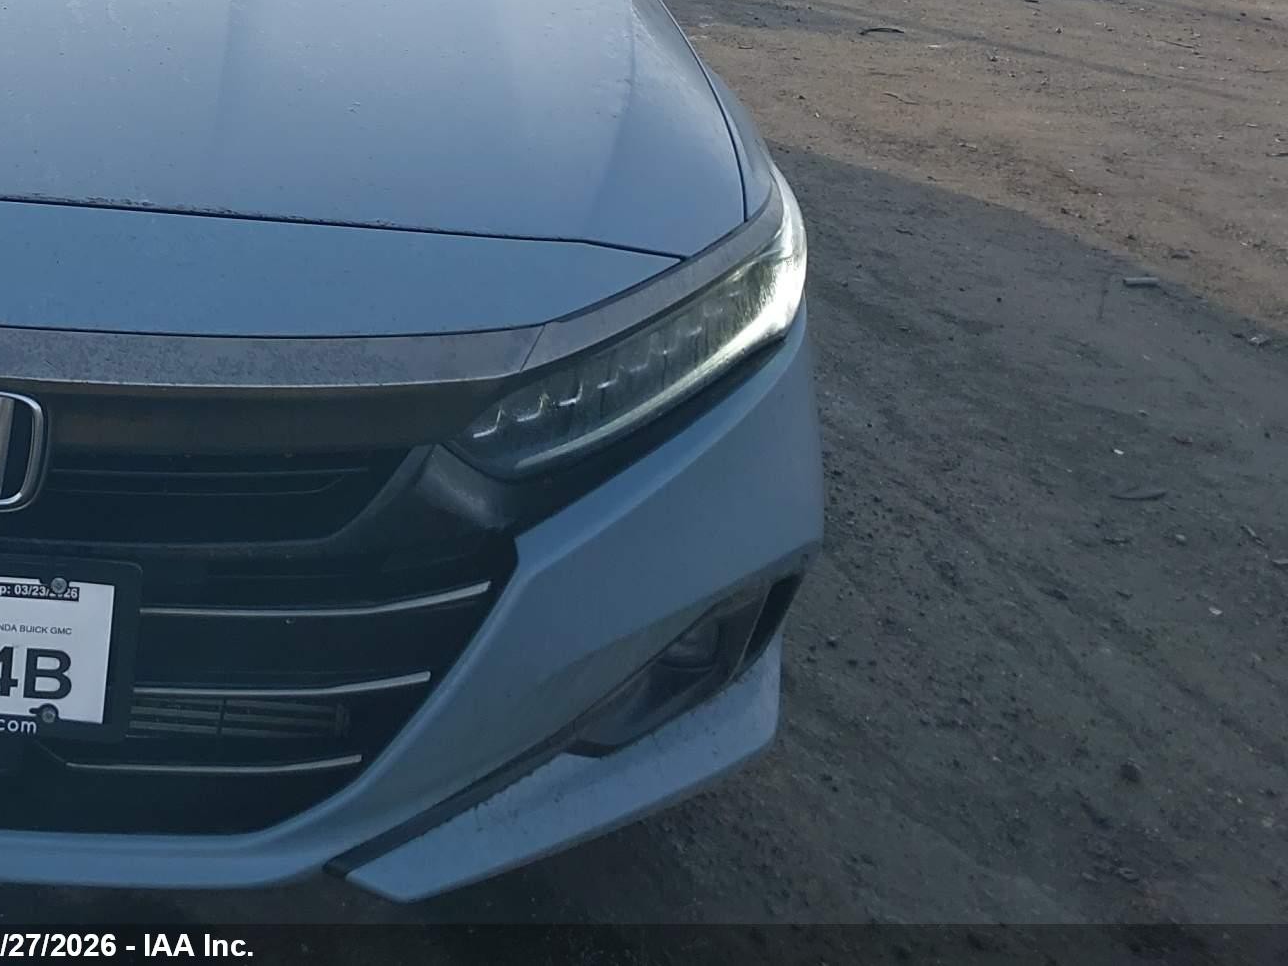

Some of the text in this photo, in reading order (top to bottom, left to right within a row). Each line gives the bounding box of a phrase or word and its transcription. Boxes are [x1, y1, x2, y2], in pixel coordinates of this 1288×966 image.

[14, 584, 78, 600] 03/23/26
[20, 625, 49, 635] BUICK
[51, 627, 73, 636] GMC
